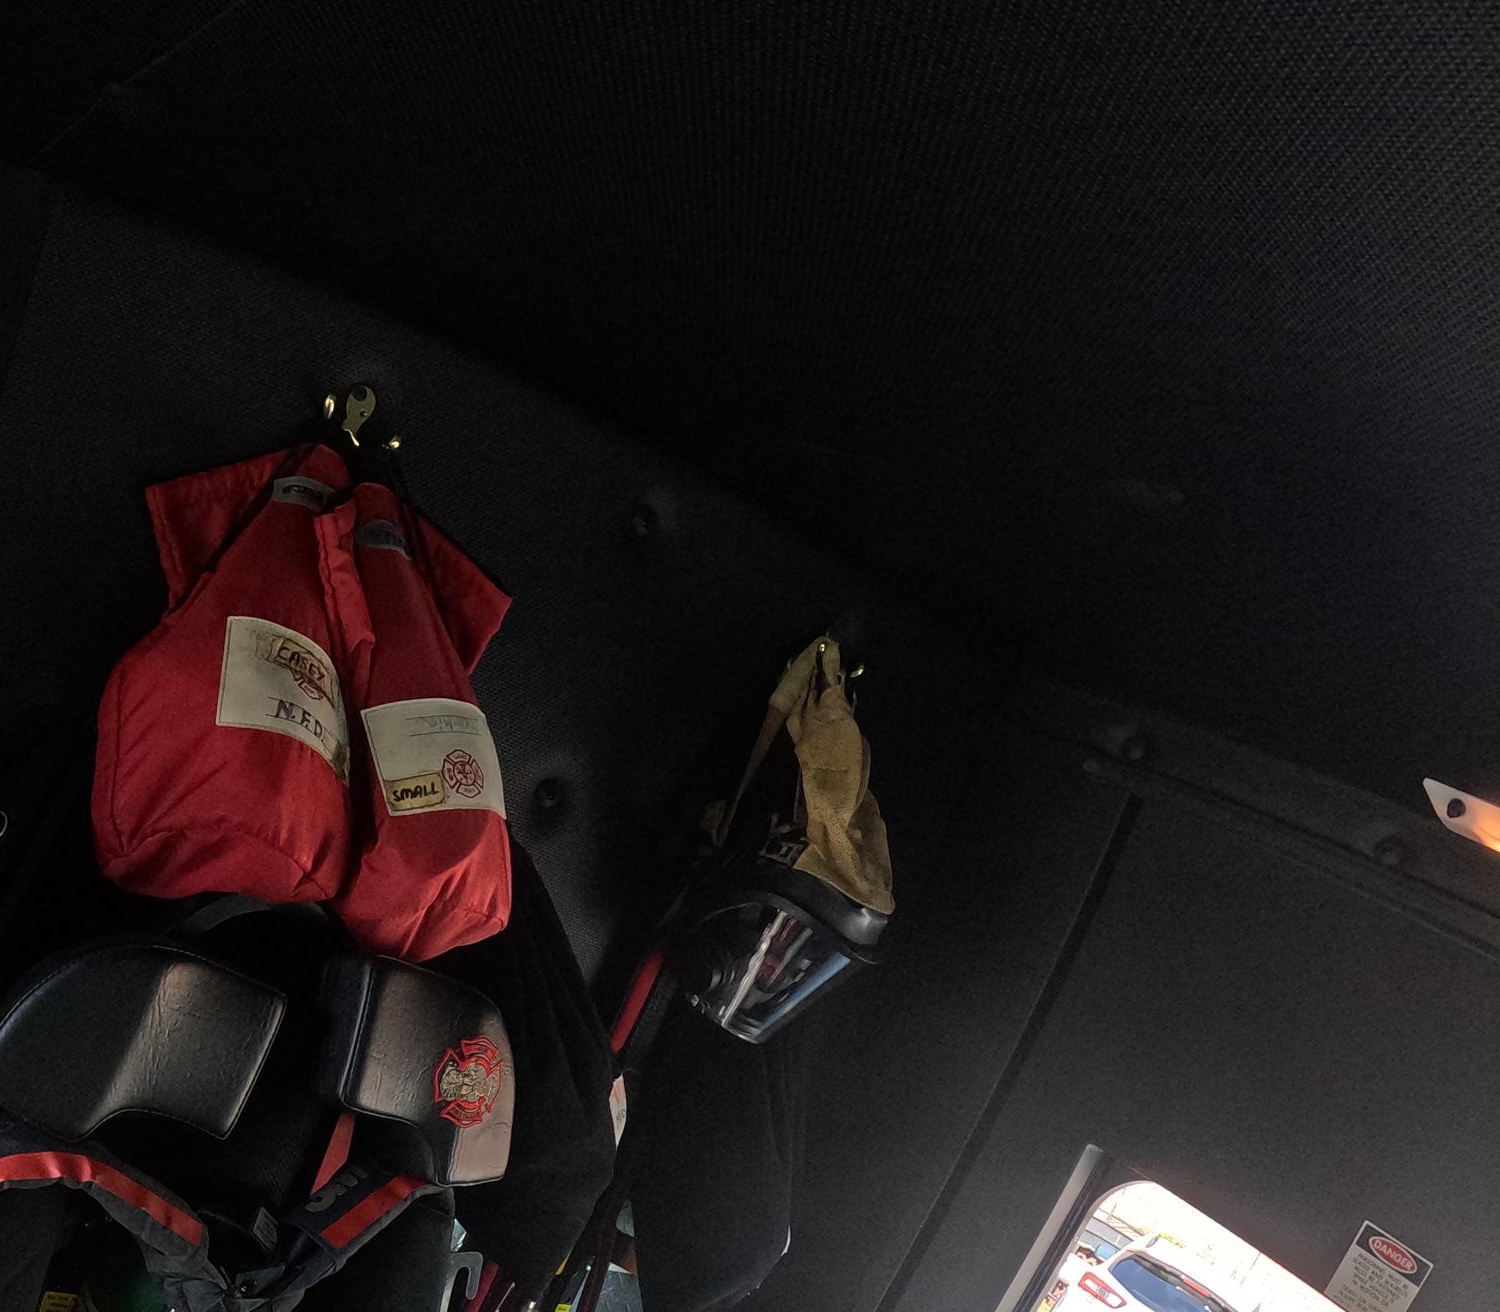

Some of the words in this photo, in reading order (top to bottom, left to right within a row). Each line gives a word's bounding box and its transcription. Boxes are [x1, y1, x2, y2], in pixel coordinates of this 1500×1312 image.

[278, 646, 325, 681] CASEY
[392, 781, 440, 802] SMALL
[1373, 1240, 1413, 1270] DANGER
